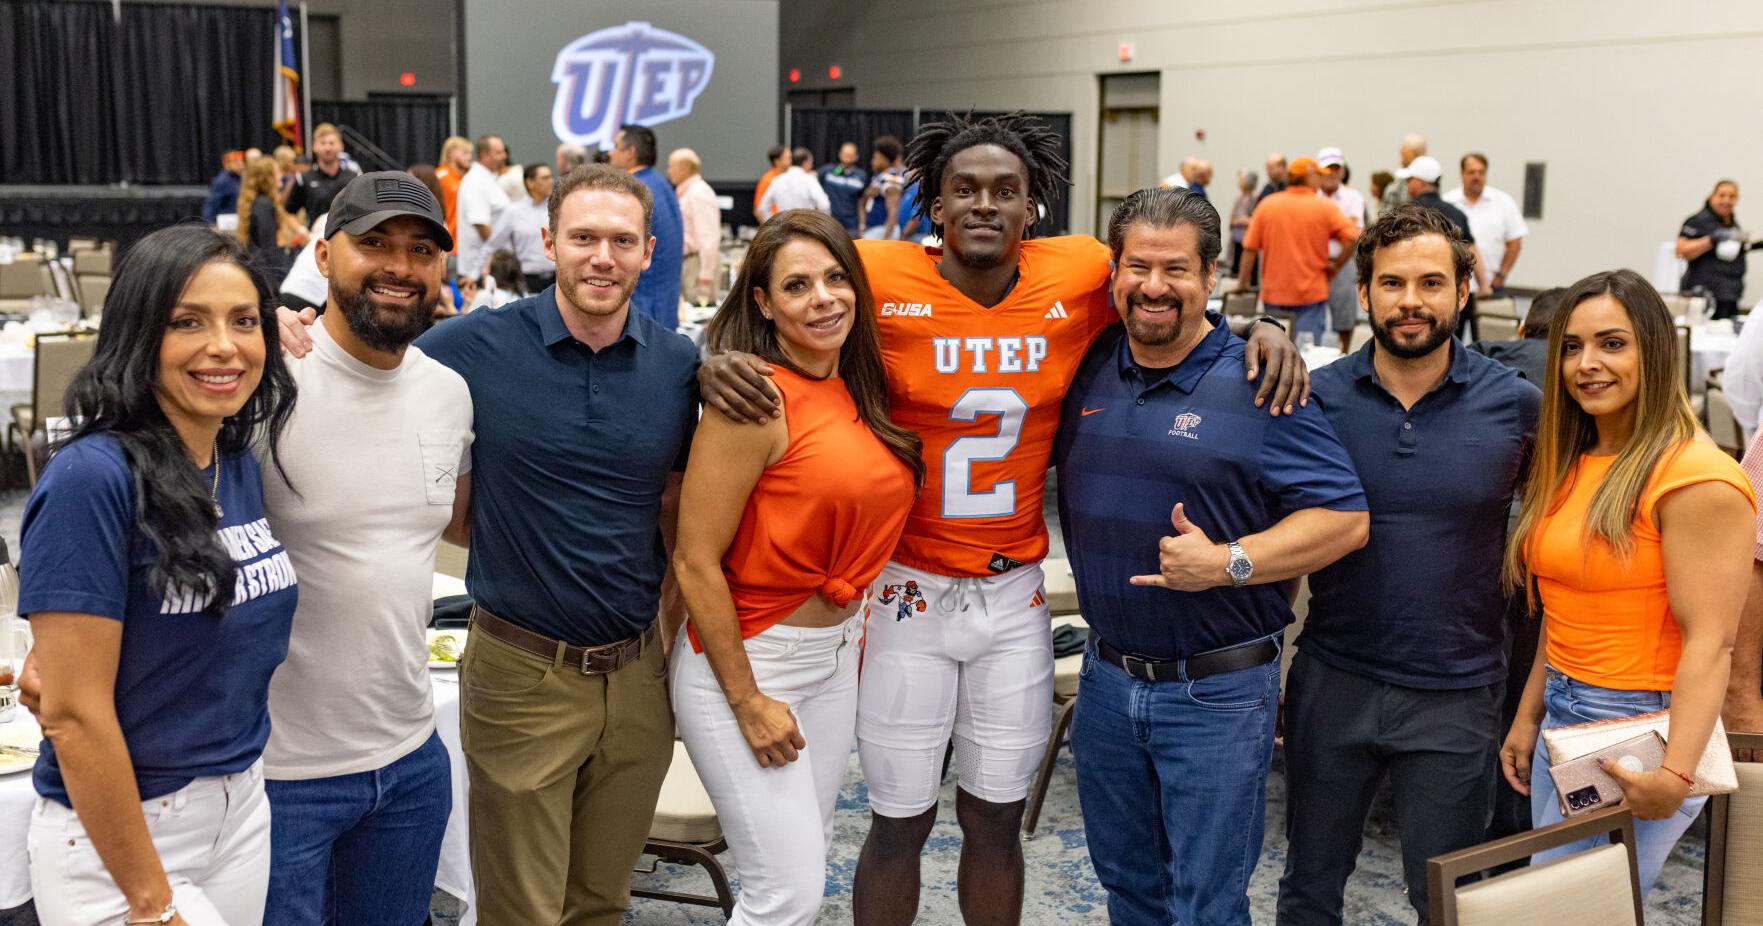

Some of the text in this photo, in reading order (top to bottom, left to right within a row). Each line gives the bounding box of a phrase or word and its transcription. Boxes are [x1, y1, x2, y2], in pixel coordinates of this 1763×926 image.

[553, 22, 714, 151] UTEP
[933, 336, 1048, 374] UTEP
[942, 387, 1030, 518] 2
[1168, 429, 1199, 440] FOOTBALL
[243, 517, 281, 554] SAF
[243, 549, 297, 601] STRON
